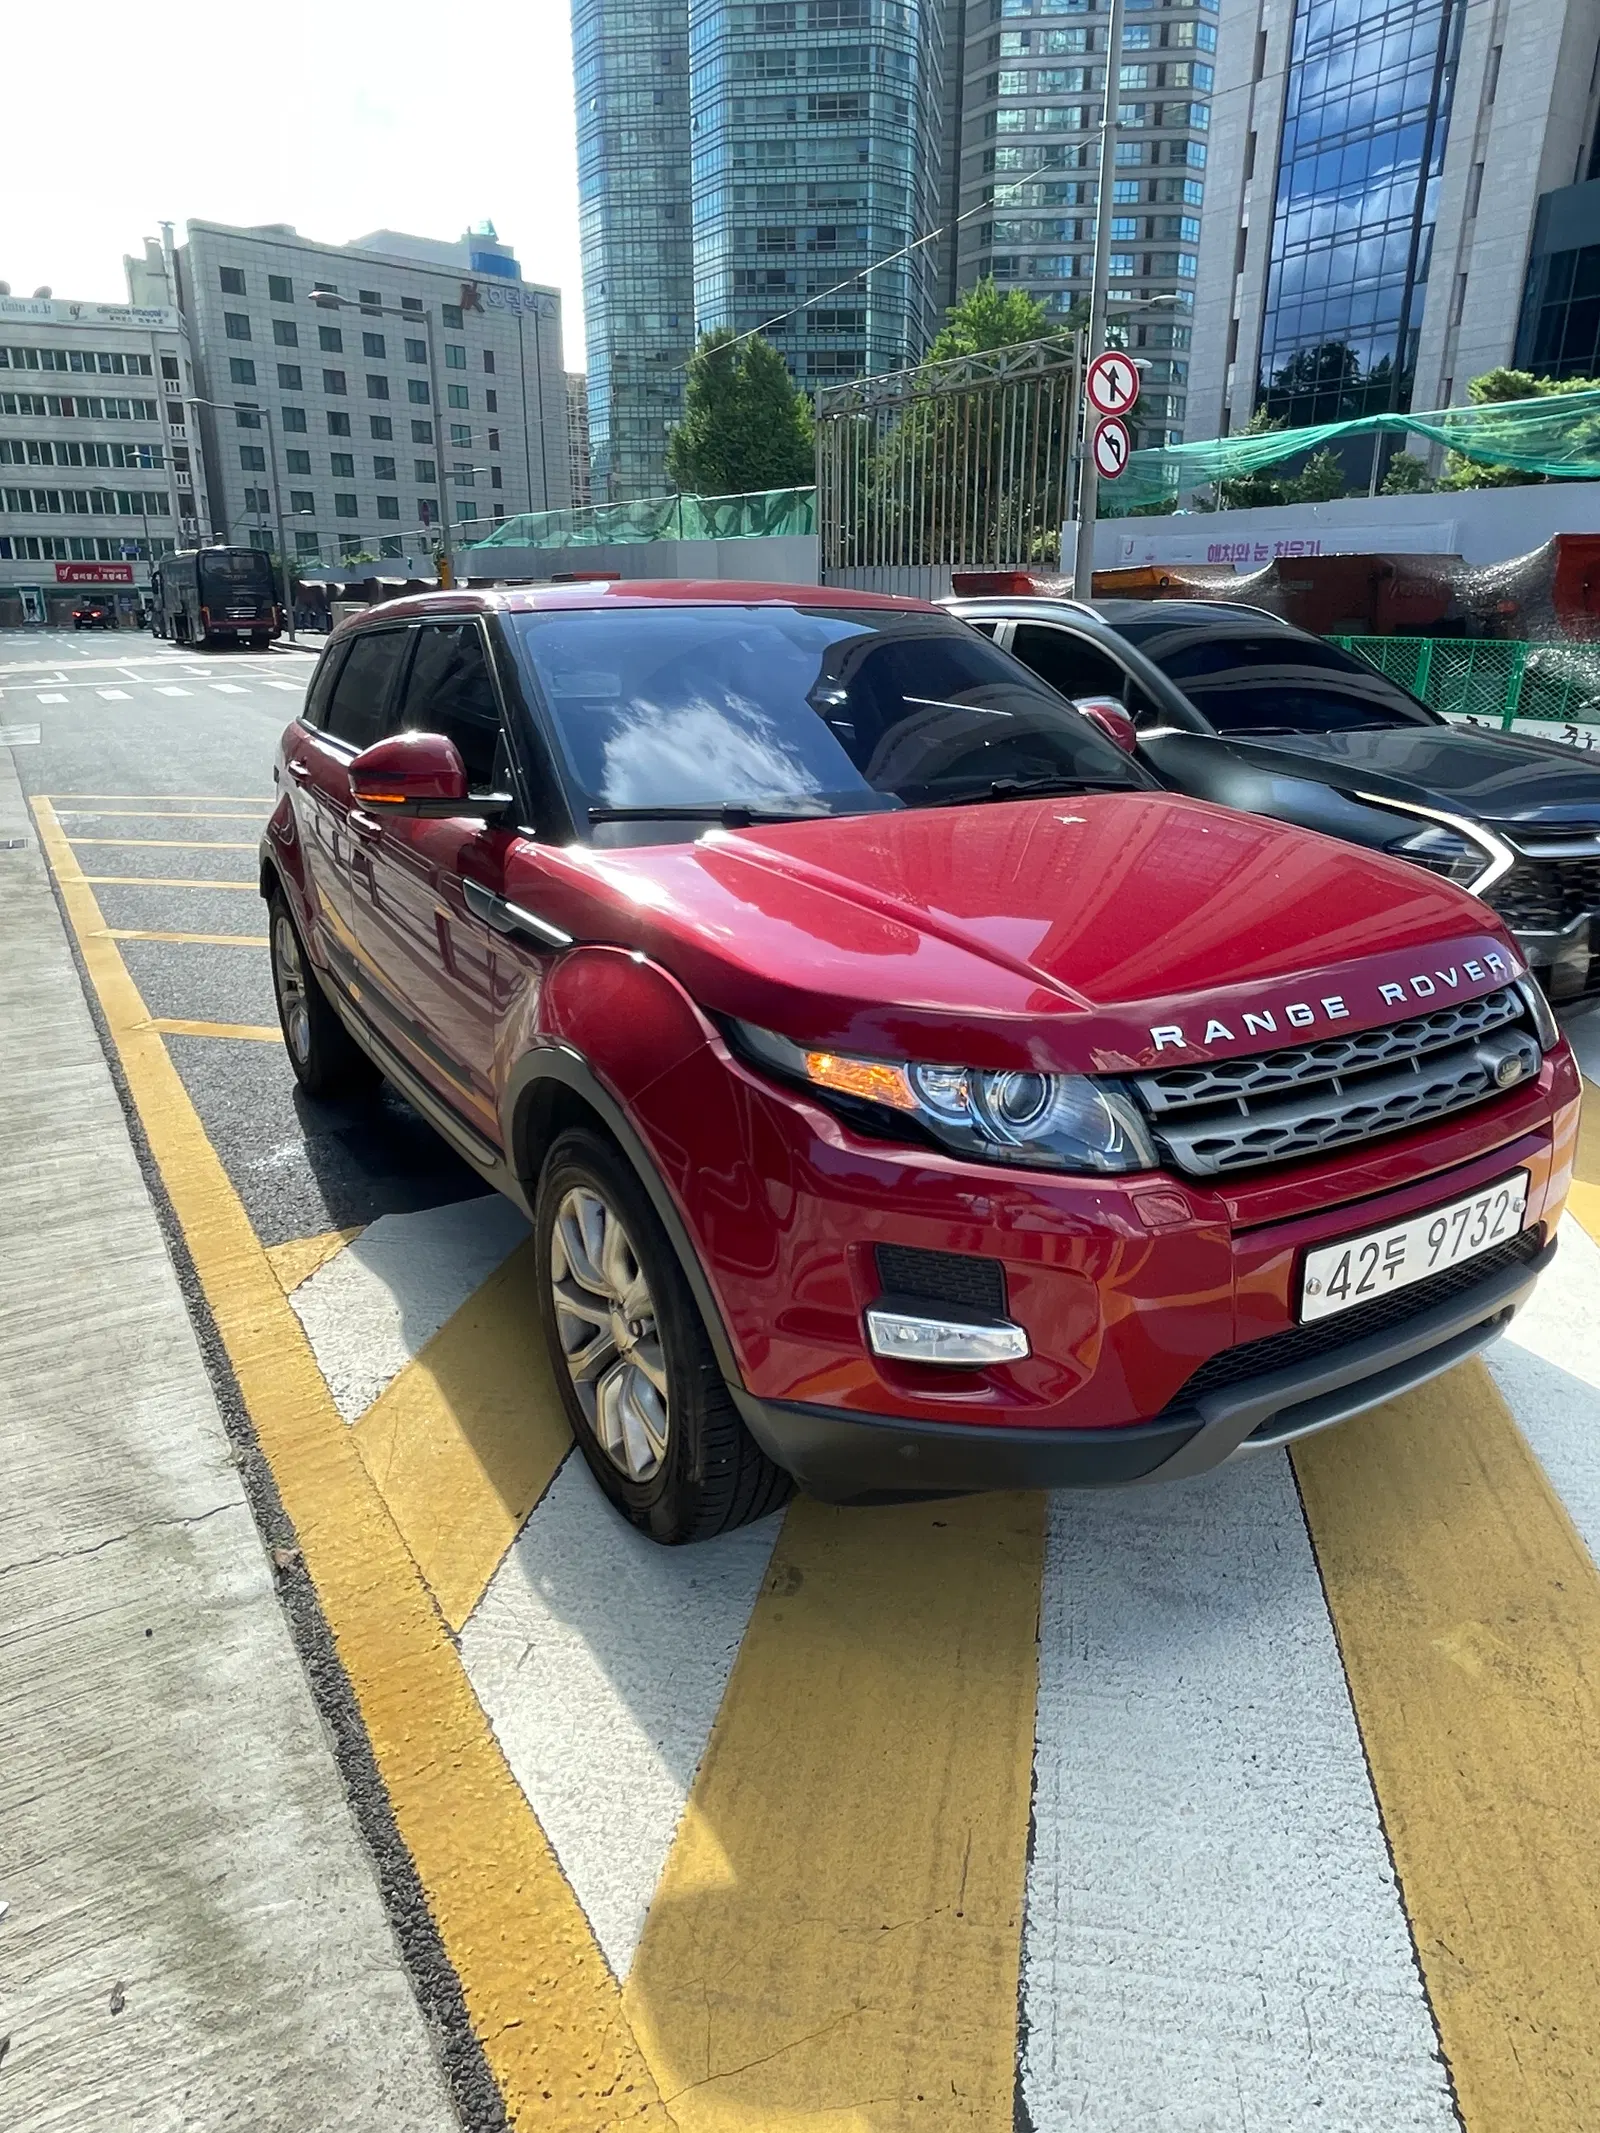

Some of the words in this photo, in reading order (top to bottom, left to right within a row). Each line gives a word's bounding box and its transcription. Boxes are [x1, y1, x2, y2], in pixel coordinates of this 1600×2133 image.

[1254, 542, 1269, 562] 눈
[1150, 995, 1351, 1051] RANGE
[1378, 952, 1506, 1006] ROVER
[1326, 1233, 1408, 1301] 42두
[1428, 1189, 1510, 1268] 9732
